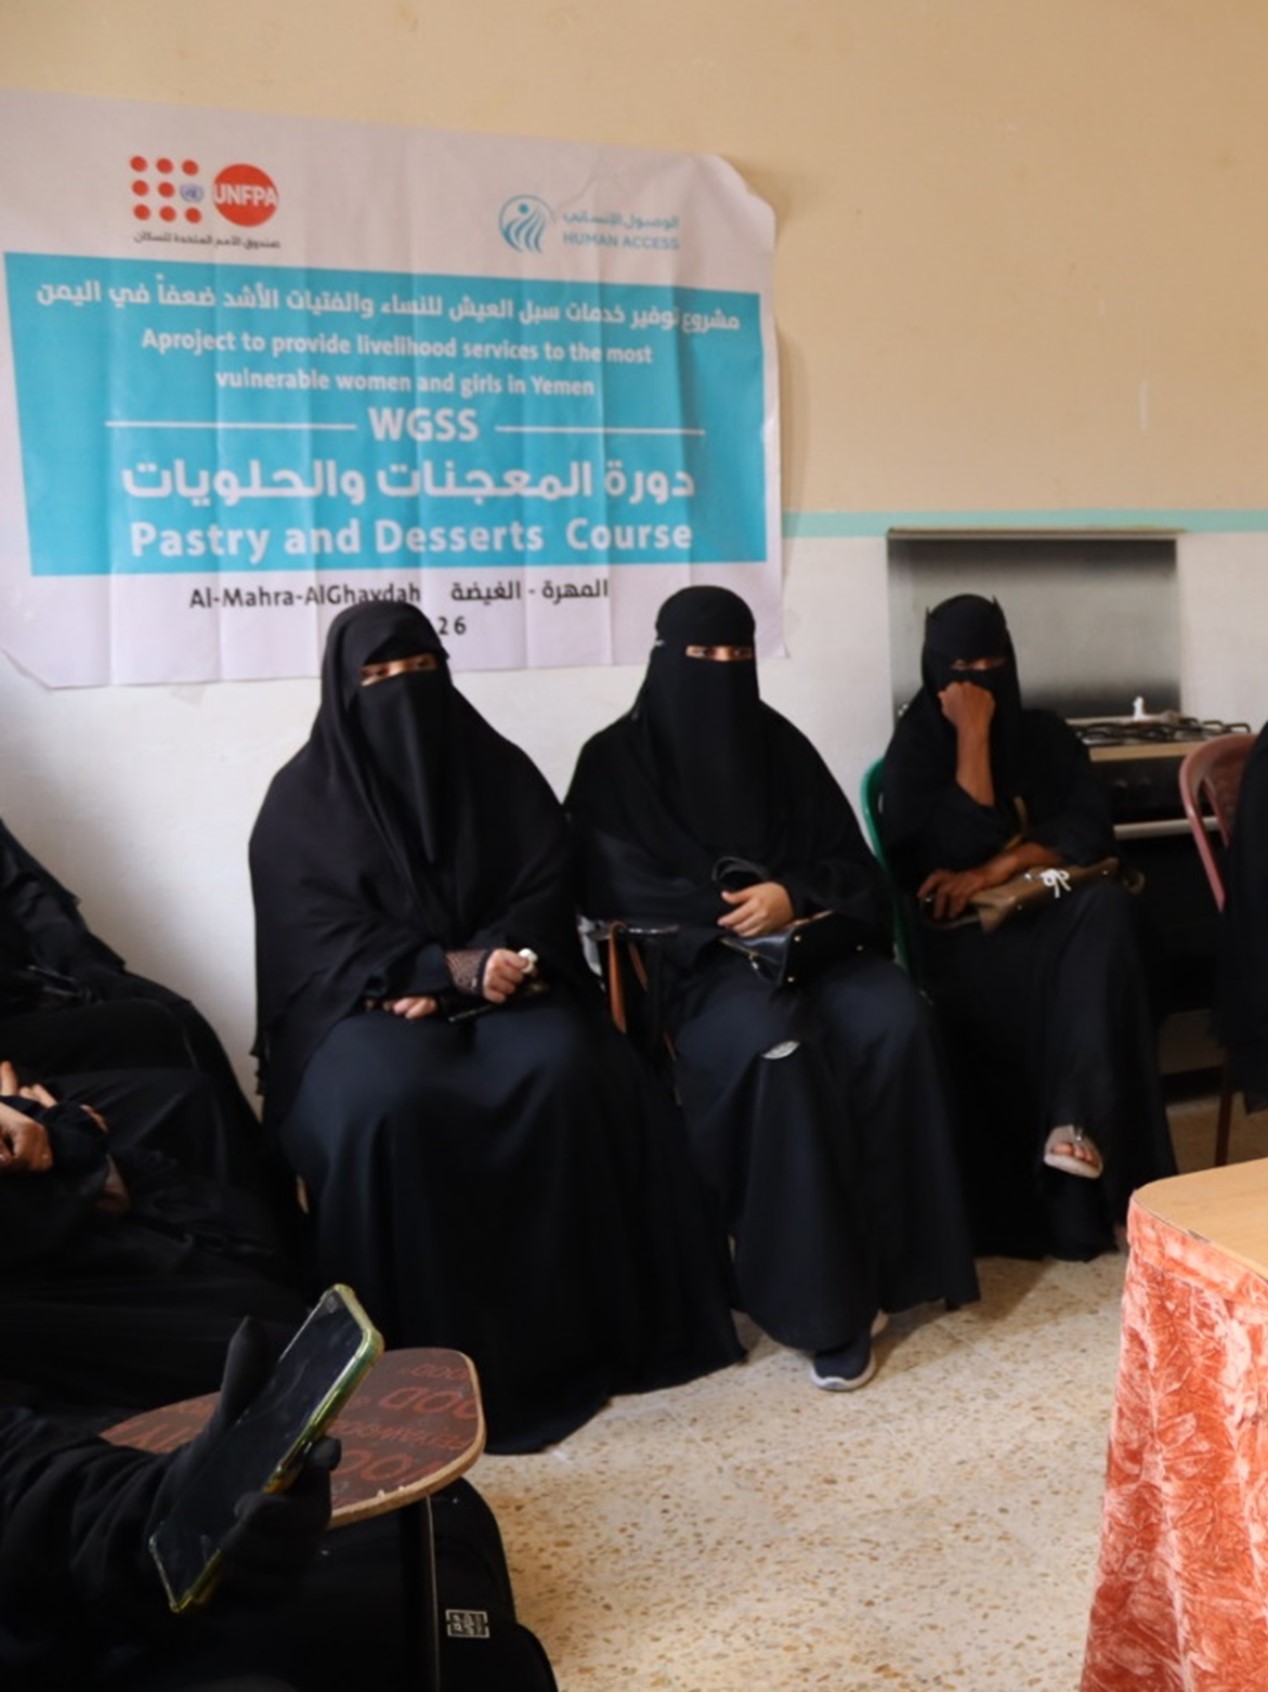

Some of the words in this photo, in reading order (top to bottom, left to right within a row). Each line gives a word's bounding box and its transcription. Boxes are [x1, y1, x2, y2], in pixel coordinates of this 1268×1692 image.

[213, 183, 278, 207] UNFPA
[562, 231, 618, 248] HUMAN
[622, 235, 681, 250] ACCESS
[36, 279, 102, 306] اليمن
[108, 283, 150, 308] في
[222, 281, 279, 310] الأشد
[286, 289, 374, 319] والفتيات
[381, 293, 444, 317] للنساء
[449, 295, 514, 323] العيش
[519, 303, 561, 325] سبل
[566, 301, 626, 324] خدمات
[629, 305, 678, 331] توفير
[681, 311, 742, 334] مشروع
[142, 328, 237, 356] Aproject
[242, 331, 266, 351] to
[272, 333, 351, 357] provide
[357, 334, 457, 357] livelihood
[462, 339, 538, 360] services
[543, 342, 565, 361] to
[569, 340, 601, 362] the
[606, 344, 653, 364] most
[214, 368, 330, 391] vulnerable
[335, 374, 411, 391] women
[416, 372, 454, 392] and
[460, 374, 503, 399] girls
[508, 374, 526, 394] in
[531, 375, 595, 396] Yemen
[368, 407, 480, 442] WGSS
[121, 458, 367, 507] والحلويات
[376, 459, 593, 506] المعجنات
[604, 458, 696, 505] دورة
[131, 521, 270, 565] Pastry
[284, 517, 361, 556] and
[375, 519, 545, 554] Desserts
[566, 517, 693, 550] Course
[451, 580, 521, 606] الغيضة
[541, 579, 609, 606] المهرة
